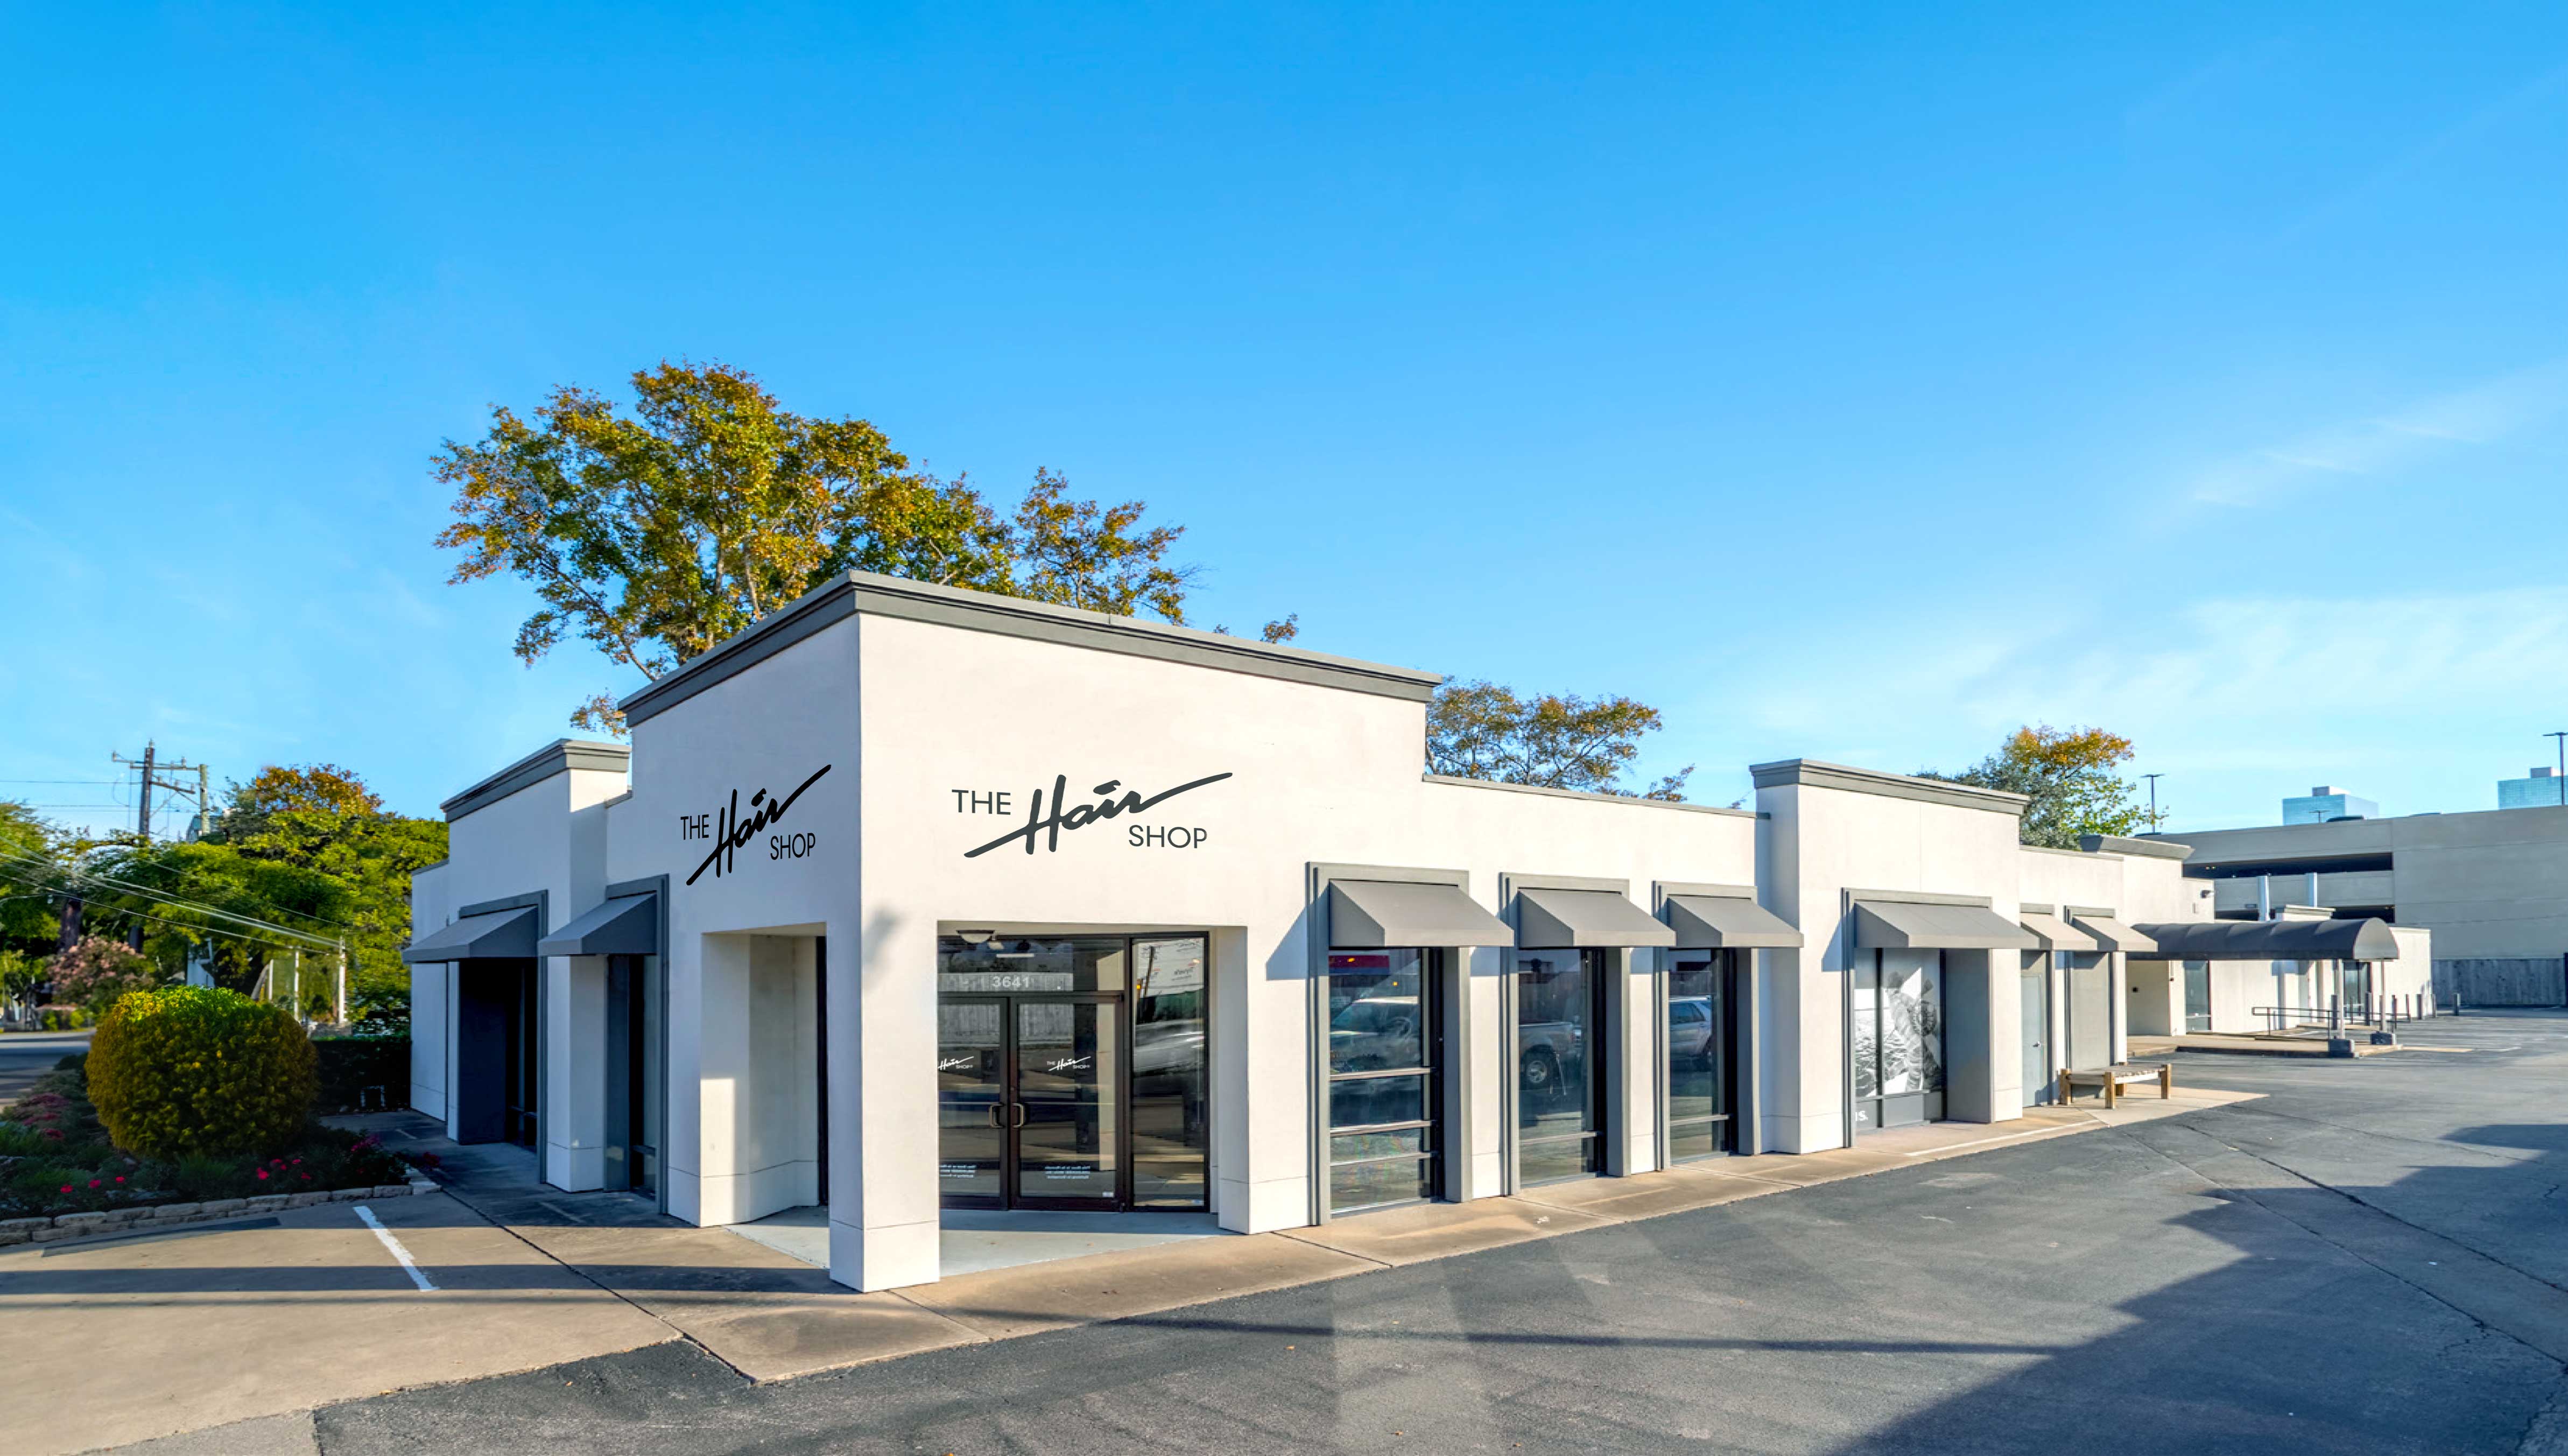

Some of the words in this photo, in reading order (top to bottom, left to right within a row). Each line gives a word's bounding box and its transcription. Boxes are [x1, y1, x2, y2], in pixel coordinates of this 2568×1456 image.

[951, 789, 1011, 815] THE
[963, 772, 1233, 858] Hair
[680, 814, 709, 840] THE
[686, 764, 832, 886] Hair
[1128, 825, 1208, 849] SHOP
[770, 832, 816, 861] SHOP
[993, 975, 1030, 988] 3641
[938, 1056, 974, 1070] Hair
[1048, 1056, 1091, 1071] Hair
